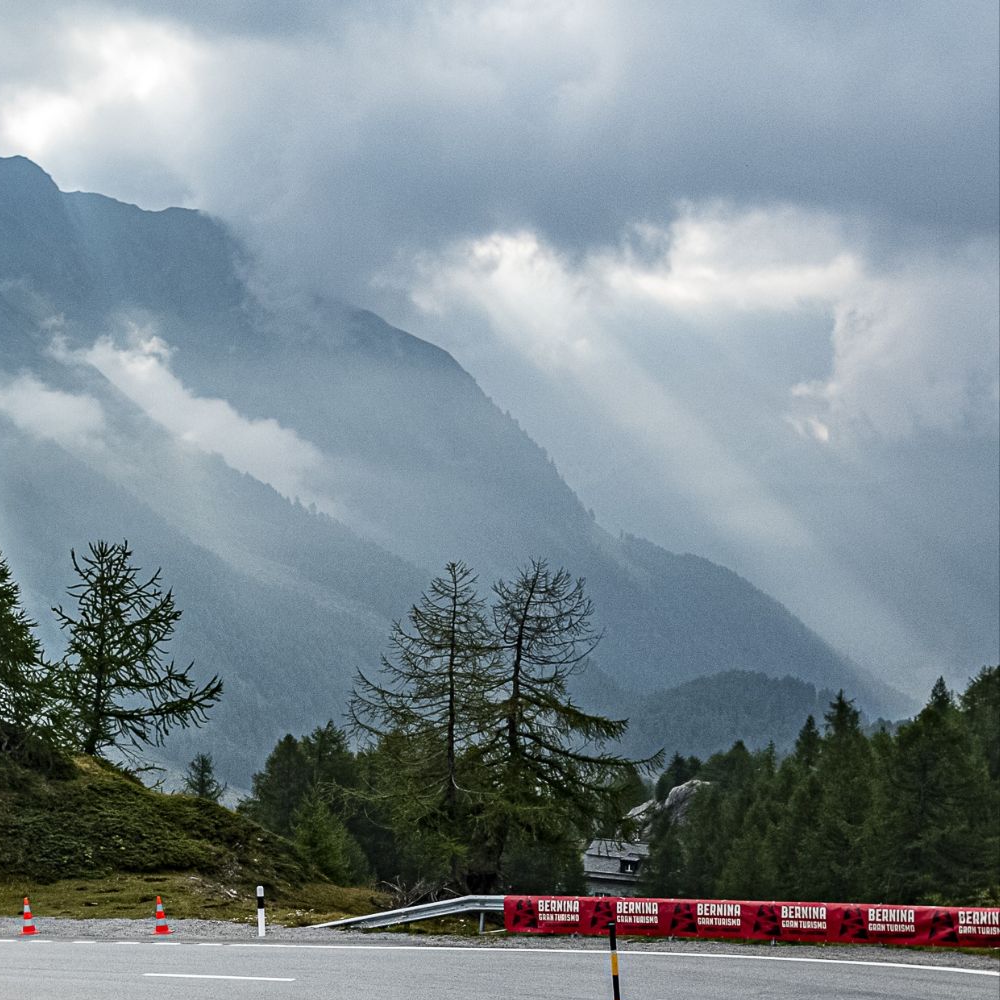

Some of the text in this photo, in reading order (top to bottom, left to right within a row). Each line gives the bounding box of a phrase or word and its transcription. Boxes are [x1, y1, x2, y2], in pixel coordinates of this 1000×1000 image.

[538, 900, 579, 913] BERNINA
[616, 901, 658, 915] BERNINA
[697, 903, 741, 917] BERNINA
[538, 913, 579, 922] GRAN TURISMO
[781, 906, 827, 920] BERNINA
[868, 909, 915, 923] BERNINA
[958, 911, 1000, 925] BERNIN
[616, 915, 658, 924] GRAN TURISMO
[697, 917, 741, 926] GRAN TURISMO
[781, 920, 827, 930] GRAN TURISMO
[868, 923, 915, 933] GRAN TURISMO
[958, 925, 1000, 935] GRAN TURISM
